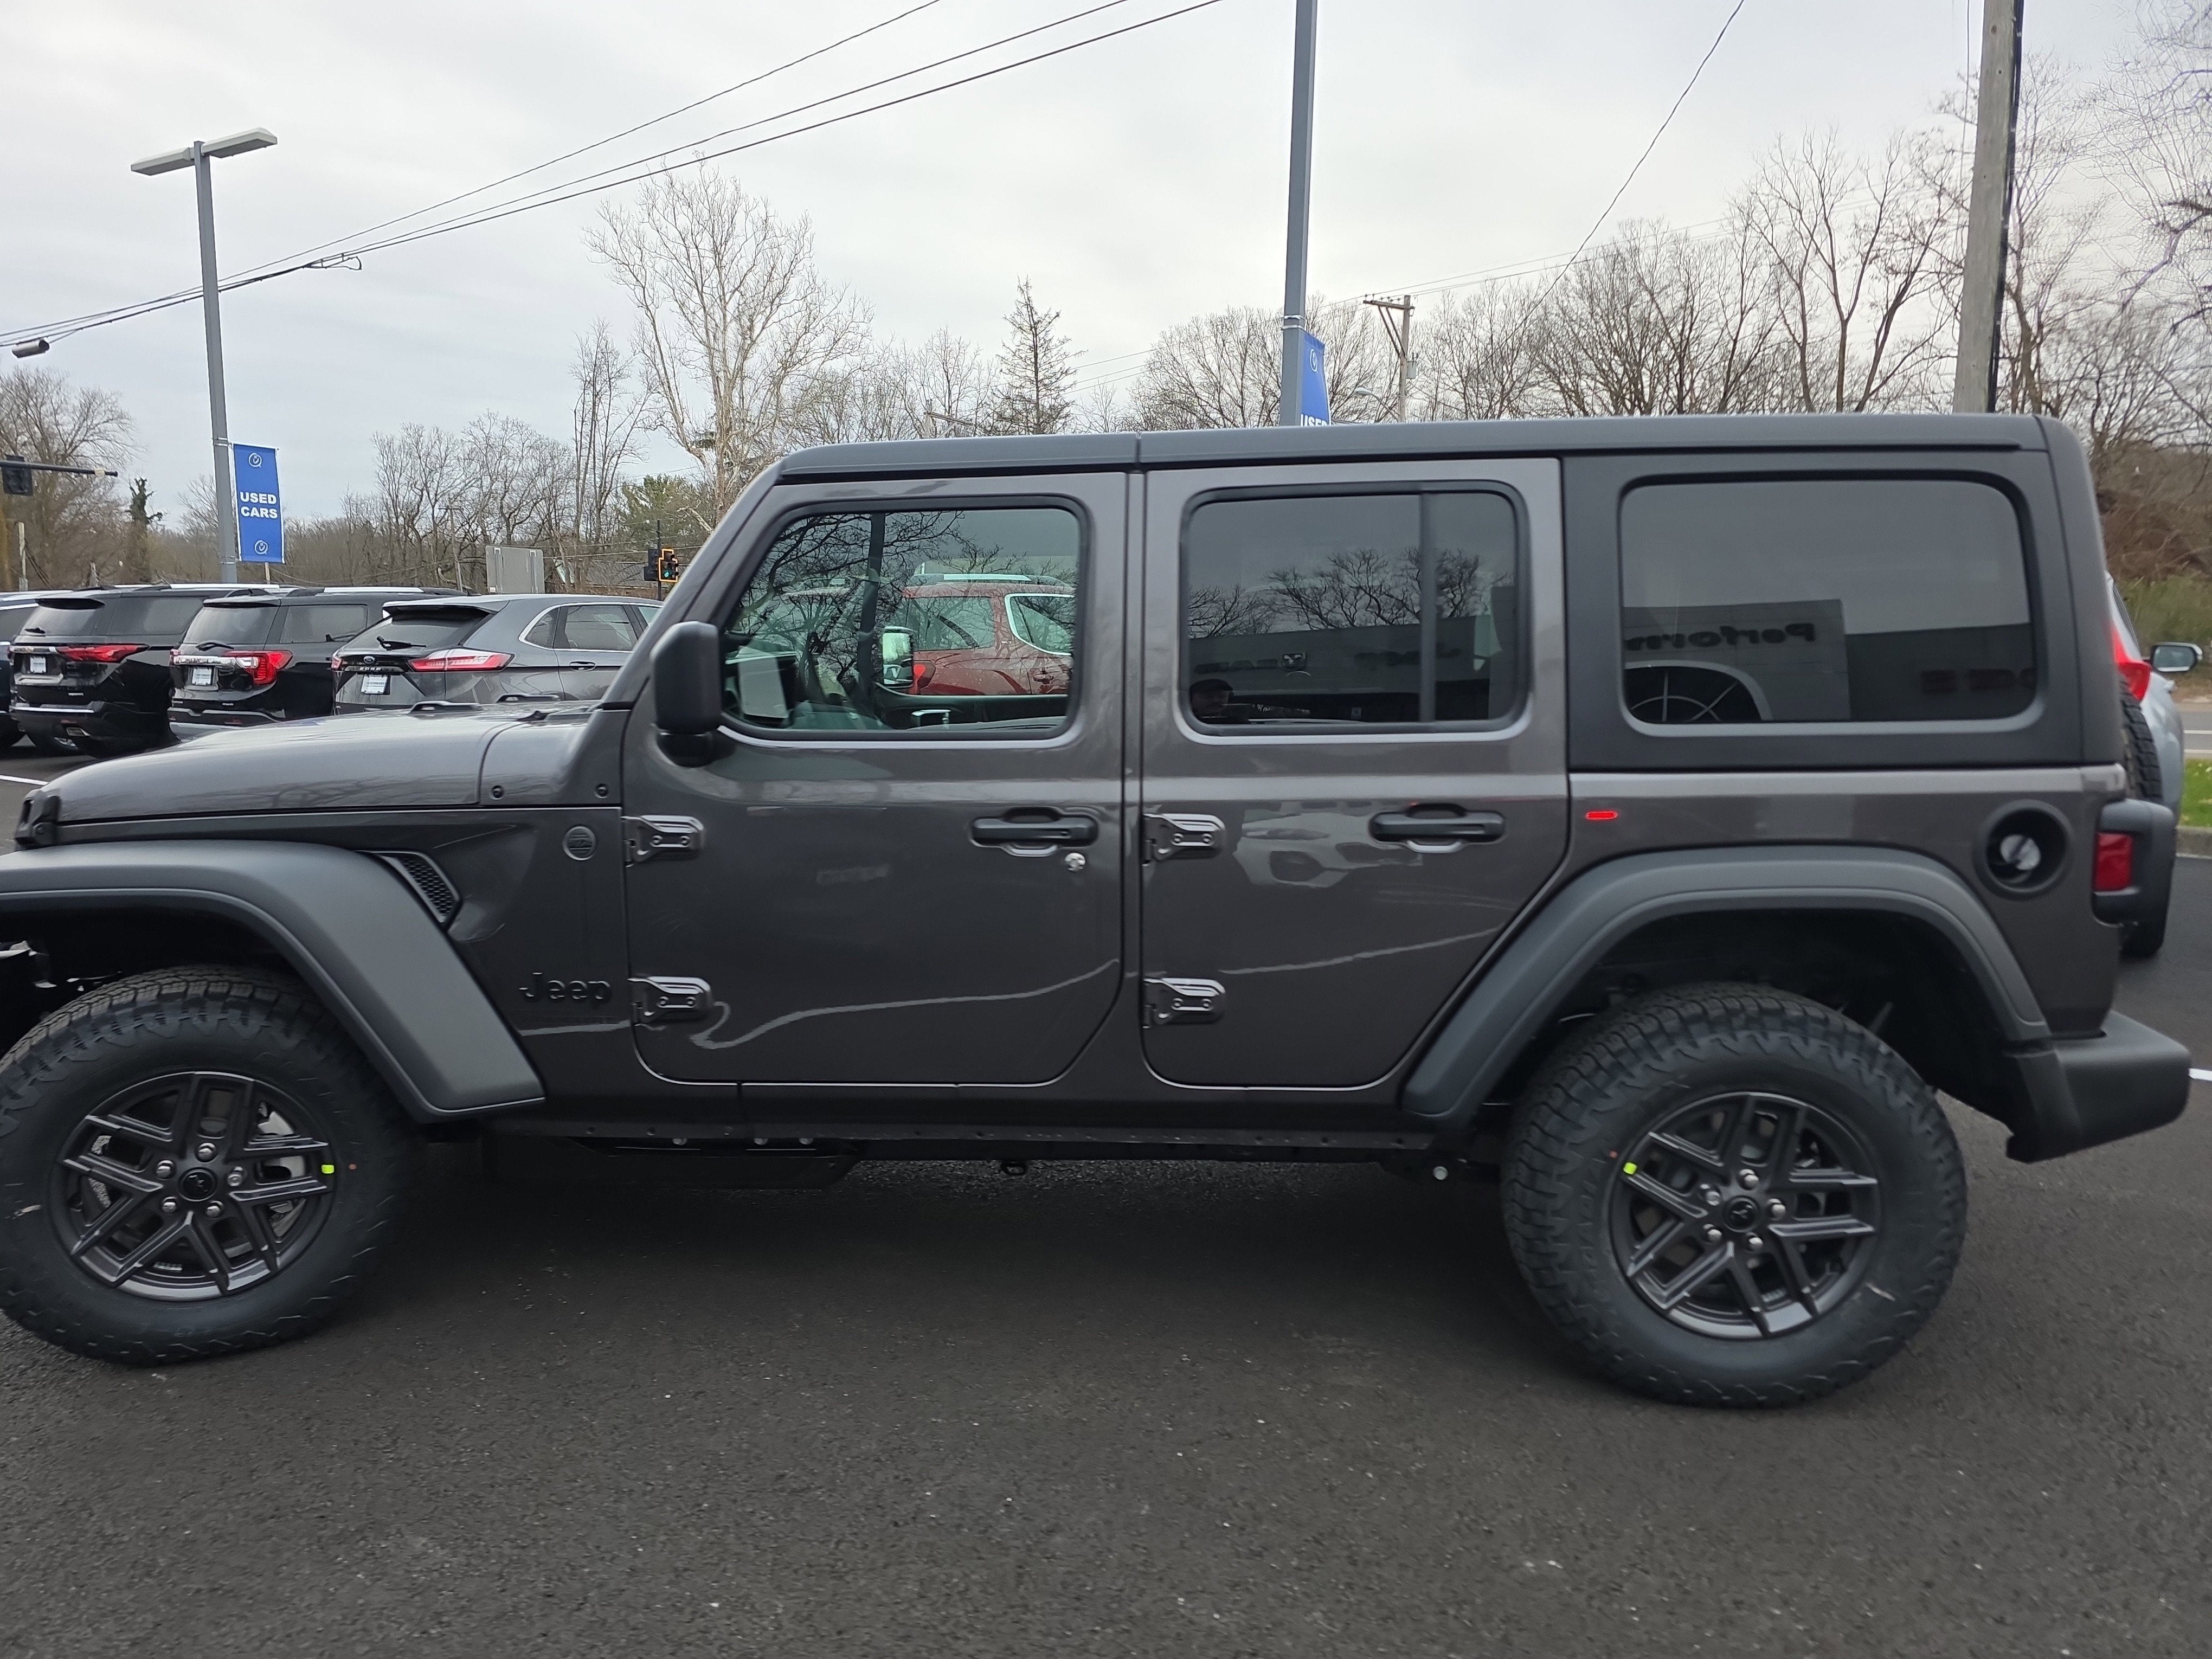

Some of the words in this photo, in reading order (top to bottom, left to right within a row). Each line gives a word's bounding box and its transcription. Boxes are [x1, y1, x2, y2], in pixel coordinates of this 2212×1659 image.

[240, 491, 277, 505] USED
[240, 506, 278, 519] CARS
[518, 972, 612, 1009] Jeep
